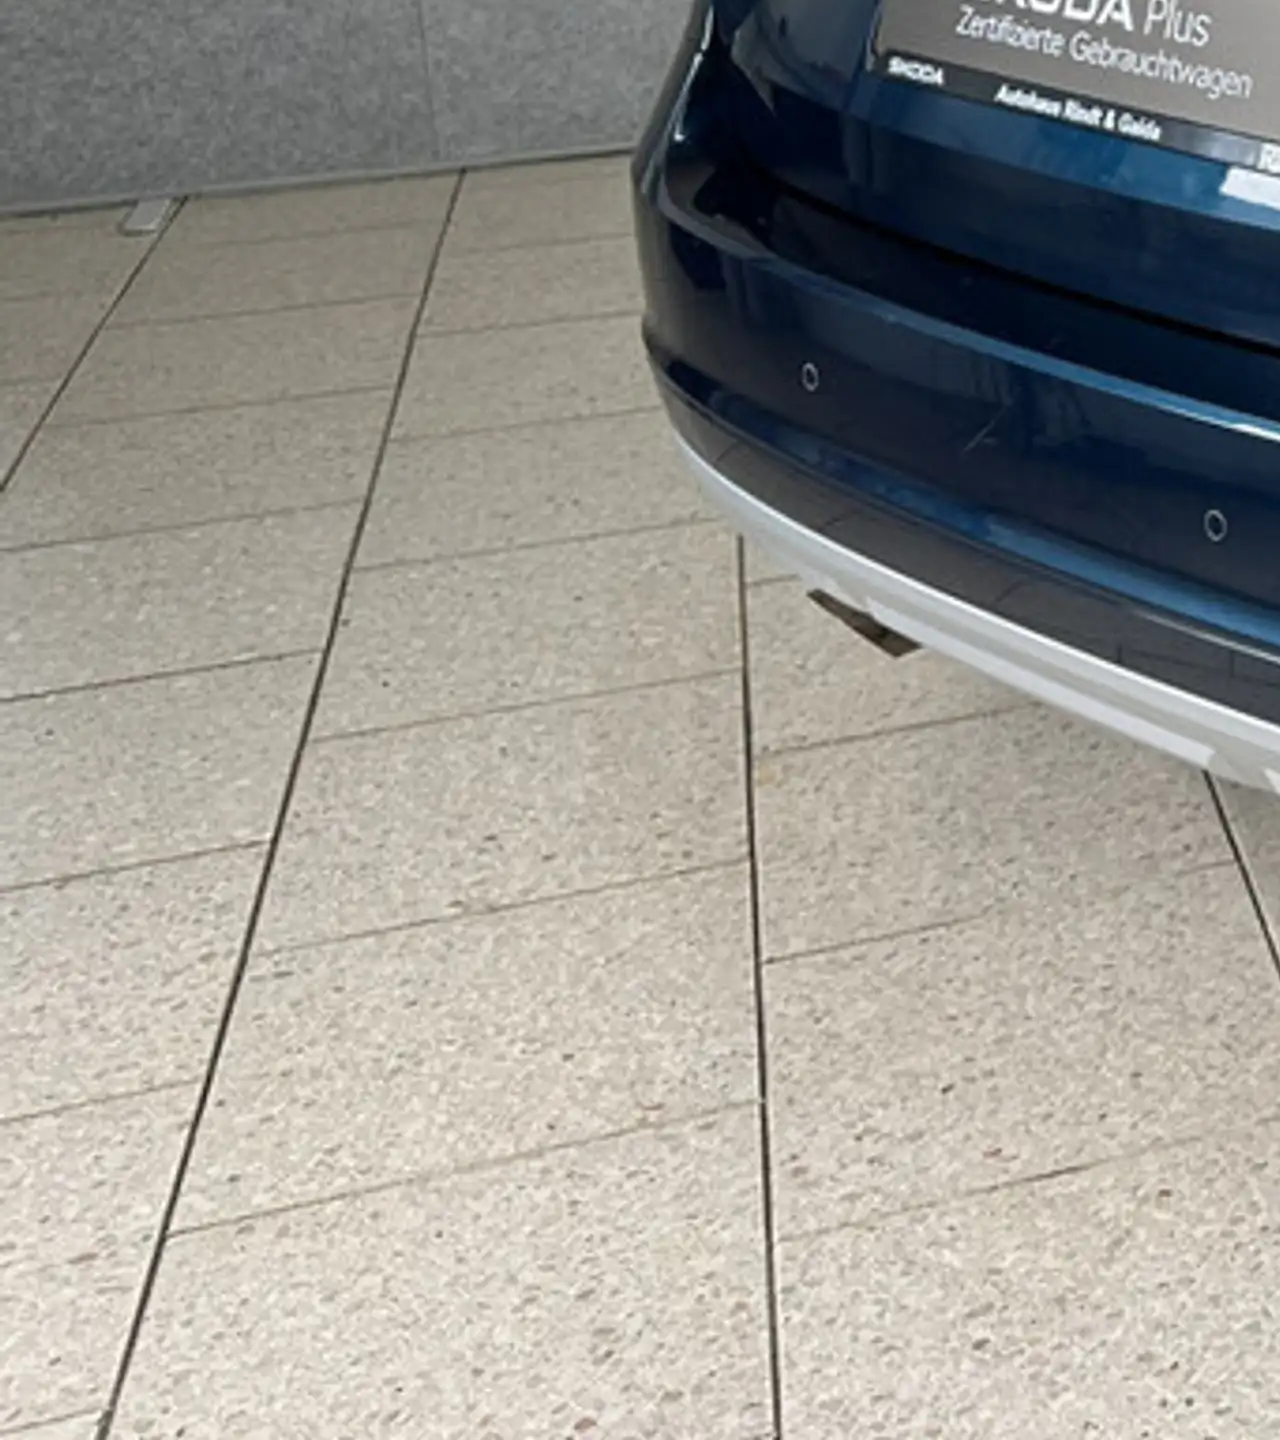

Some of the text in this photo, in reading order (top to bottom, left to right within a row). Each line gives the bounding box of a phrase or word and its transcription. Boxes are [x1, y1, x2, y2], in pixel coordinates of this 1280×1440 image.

[955, 3, 1253, 100] Zertifizierte Gebrauchtwagen
[993, 82, 1063, 118] Autohaus
